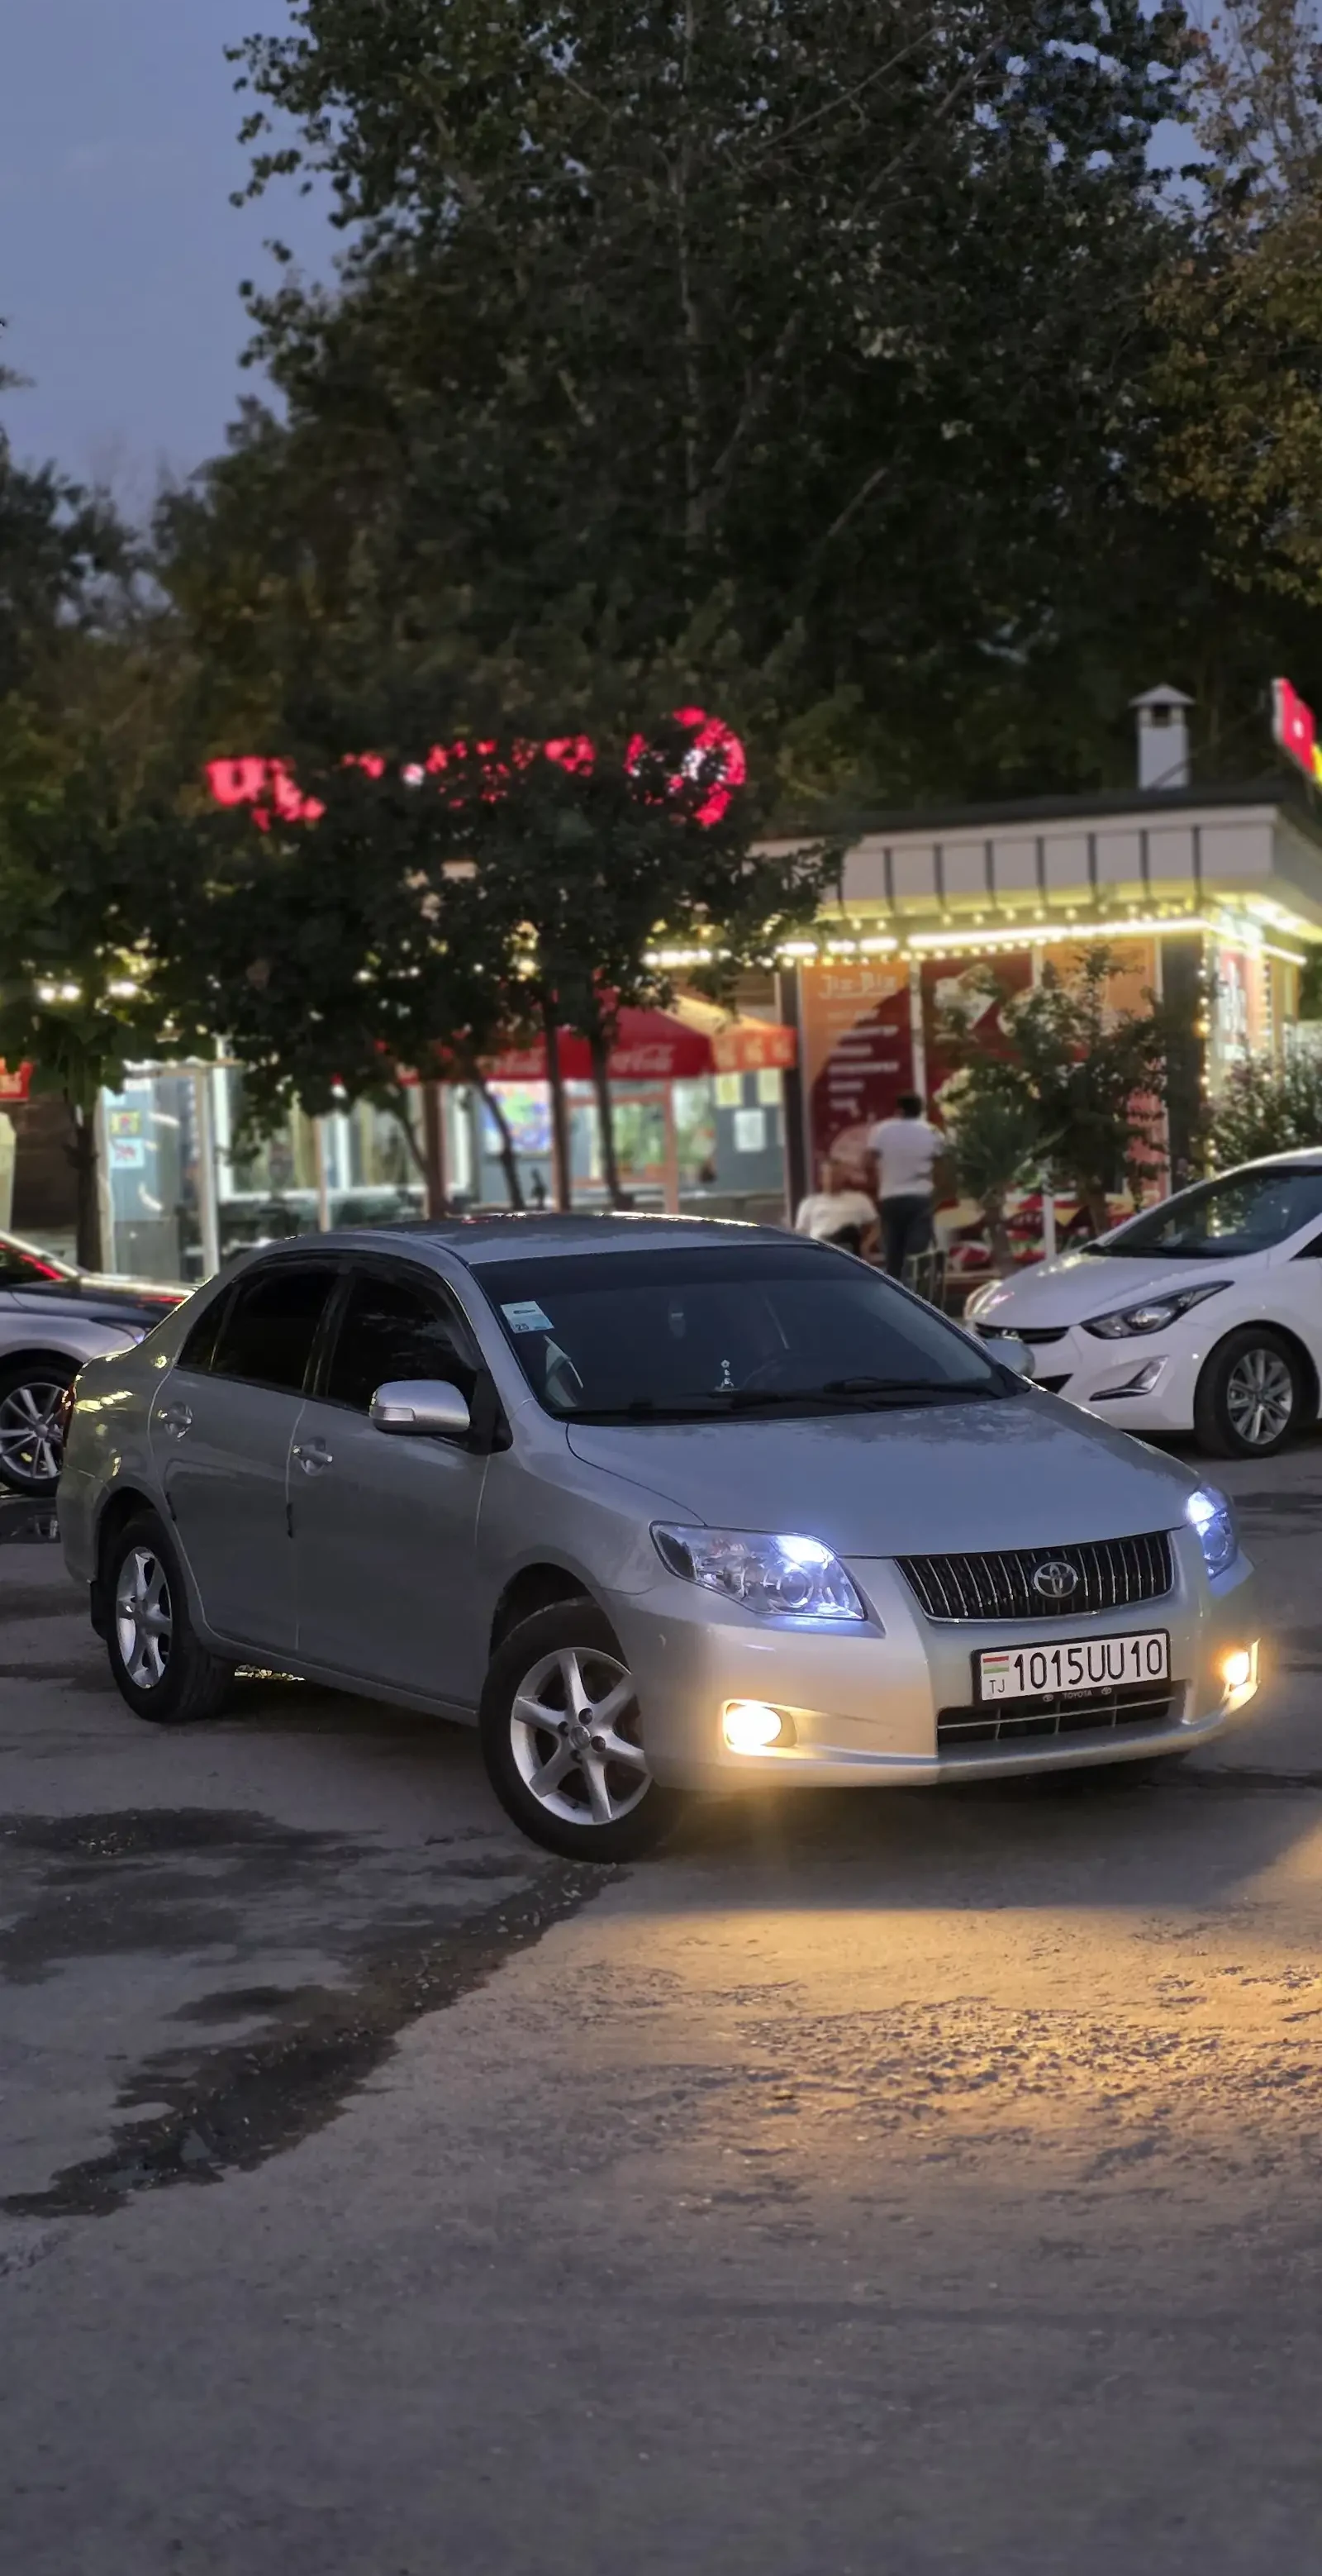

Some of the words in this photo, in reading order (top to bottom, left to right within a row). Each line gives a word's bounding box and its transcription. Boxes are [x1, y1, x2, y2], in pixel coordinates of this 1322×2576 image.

[1014, 1639, 1163, 1691] 1015UU10
[989, 1678, 1006, 1694] TJ
[1062, 1689, 1092, 1699] TOYOTA
